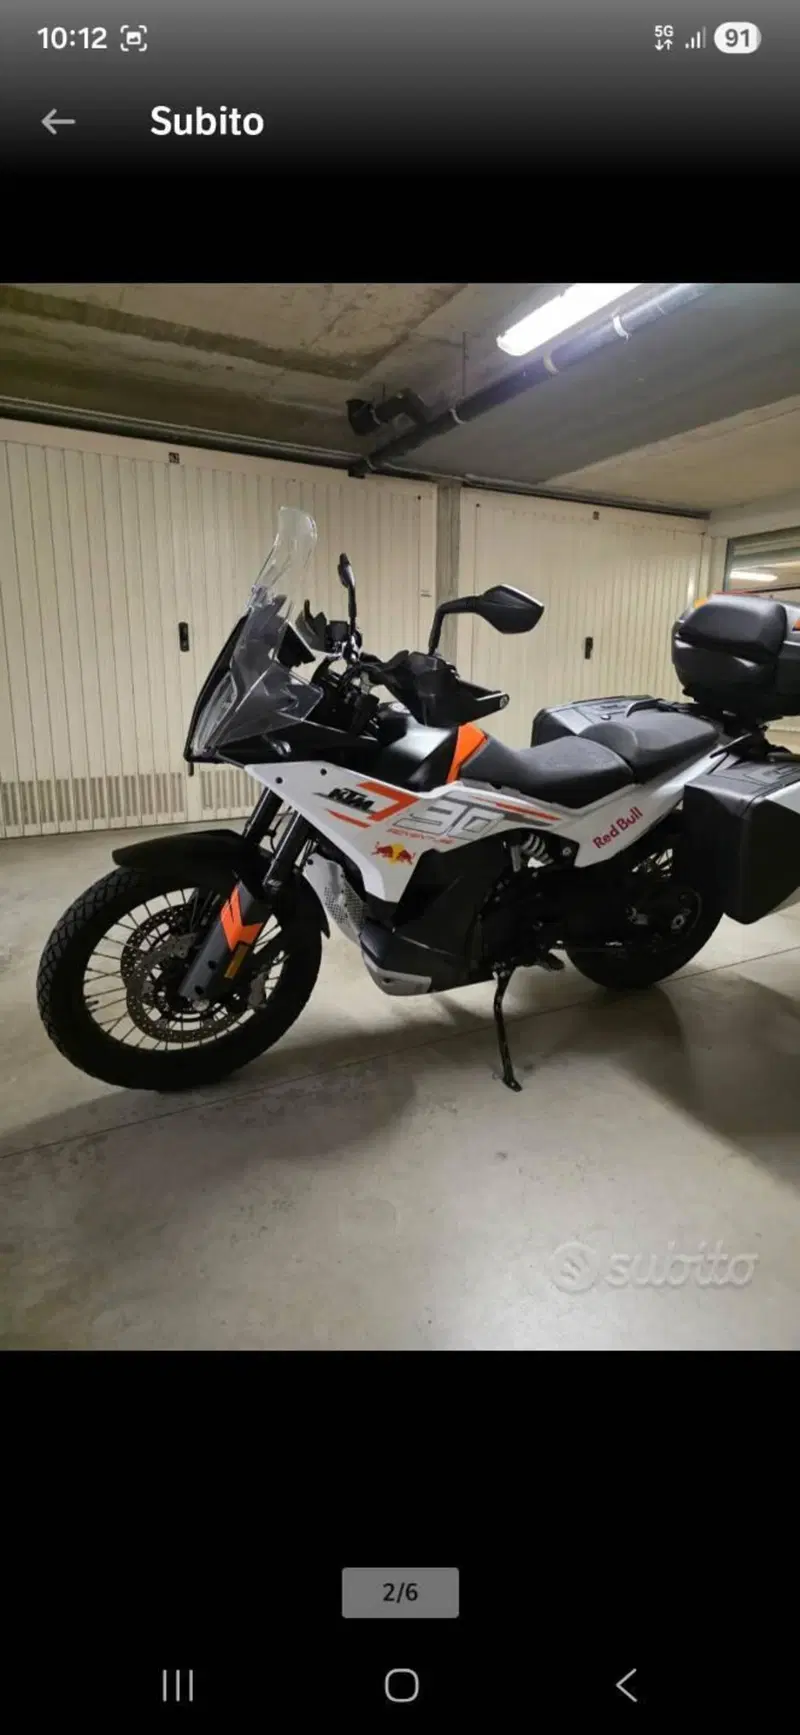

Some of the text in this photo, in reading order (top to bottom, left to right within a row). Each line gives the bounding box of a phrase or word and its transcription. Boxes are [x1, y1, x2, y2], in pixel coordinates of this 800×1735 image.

[327, 787, 375, 812] KTM
[592, 806, 643, 849] Red Bull
